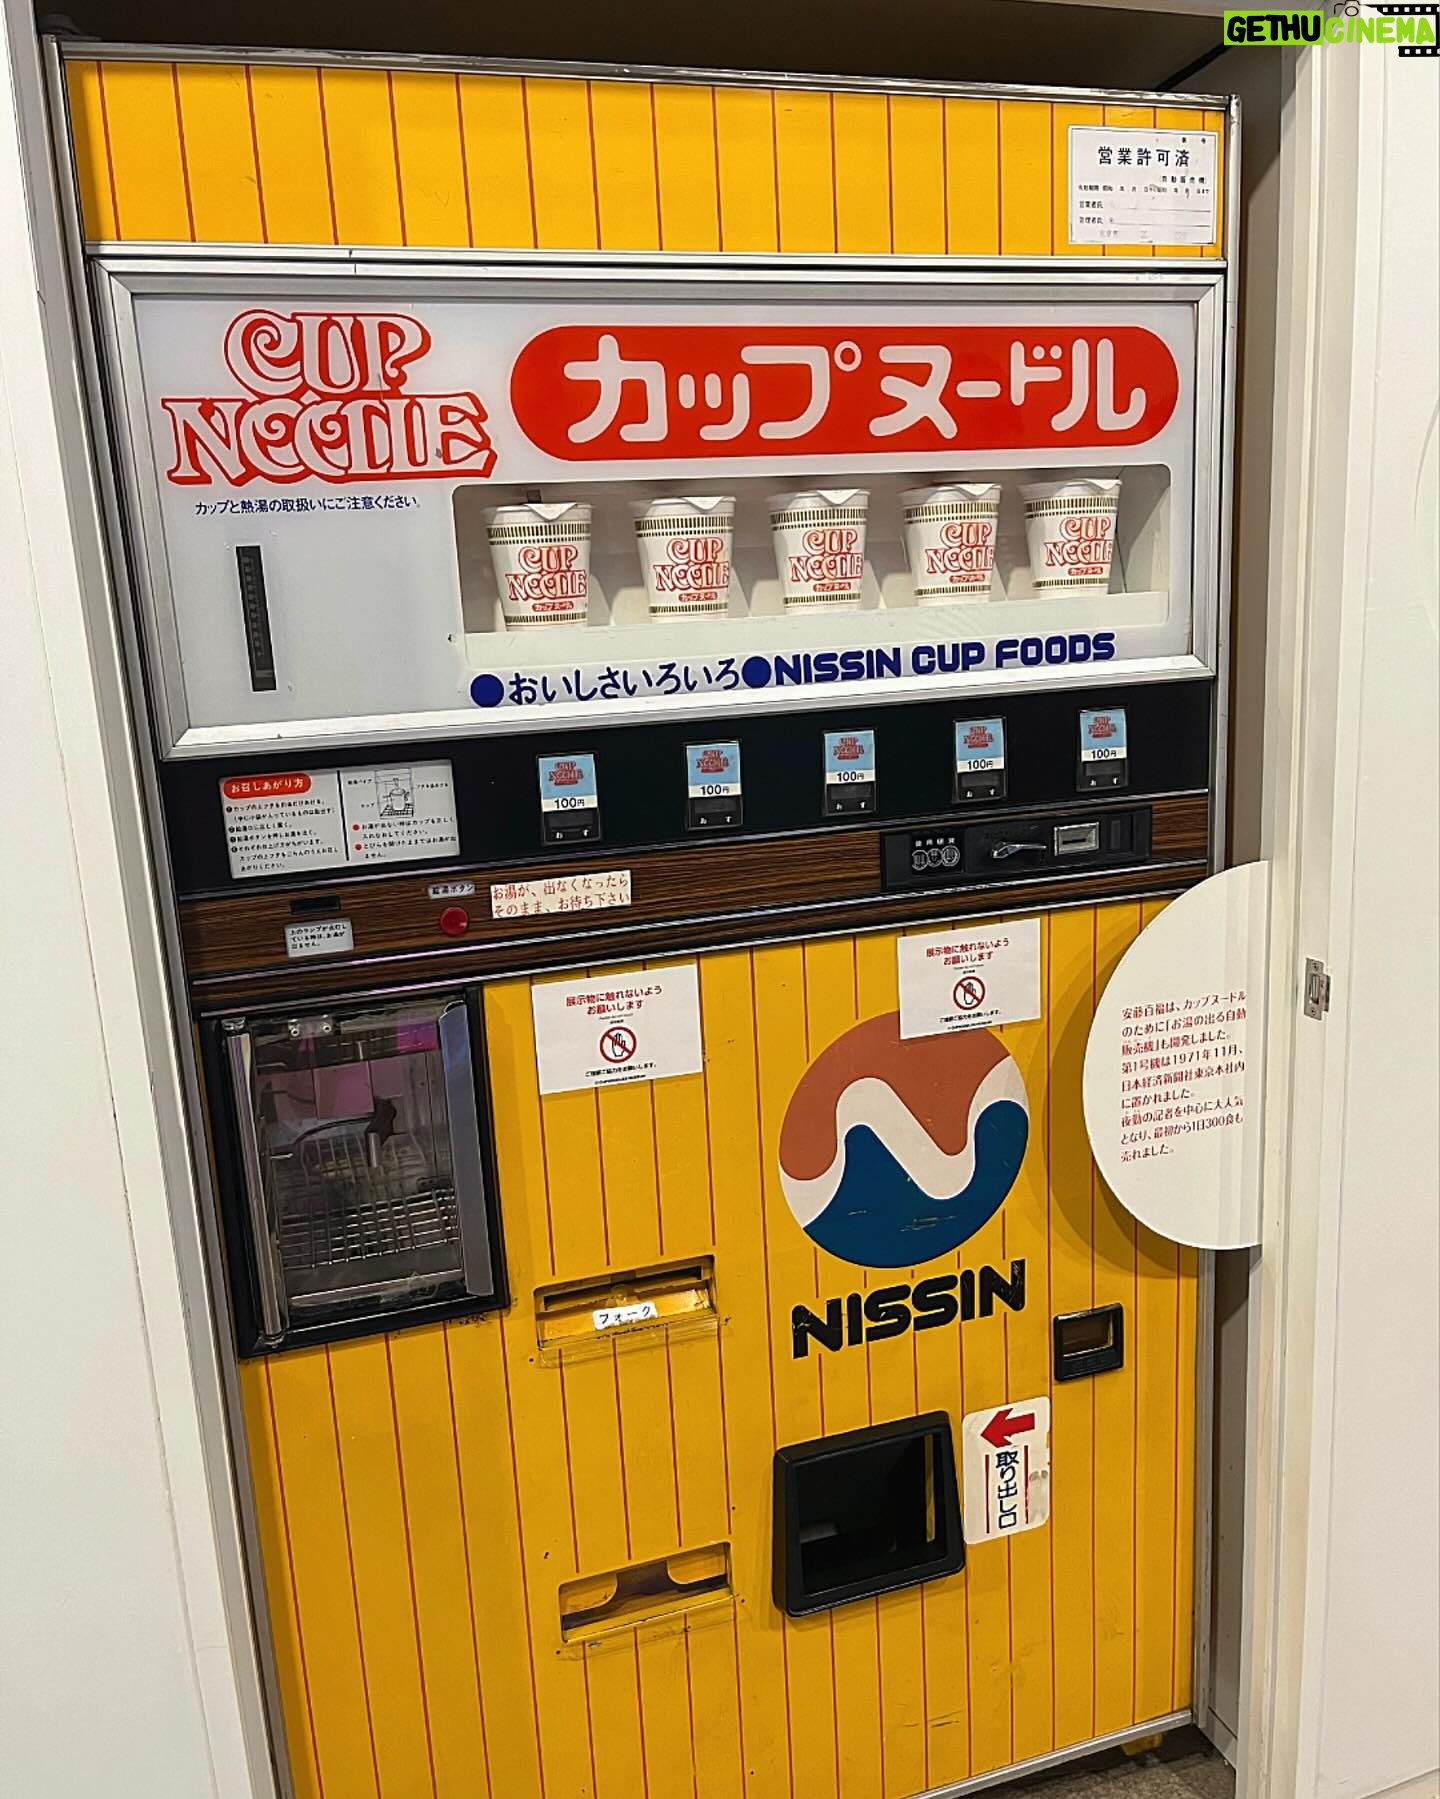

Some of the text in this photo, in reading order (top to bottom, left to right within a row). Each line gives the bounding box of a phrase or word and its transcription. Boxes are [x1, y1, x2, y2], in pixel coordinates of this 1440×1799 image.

[1098, 146, 1190, 167] 営業許可済
[223, 309, 432, 397] CUP
[563, 334, 1147, 444] カップヌードル
[160, 392, 498, 487] NOODLE
[195, 495, 421, 516] カップと熱湯の取扱いにご注意ください。
[940, 522, 992, 549] CUP
[1060, 517, 1111, 542] CUP
[667, 537, 724, 567] CUP
[803, 529, 858, 555] CUP
[518, 545, 578, 574] CUP
[508, 632, 1115, 706] おいしさいろいろ NISSIN CUP FOODS
[967, 759, 994, 770] 100円
[1091, 748, 1117, 760] 100円
[231, 778, 304, 793] お召しあがり方
[837, 772, 864, 782] 100円
[700, 784, 729, 796] 100円
[554, 797, 585, 809] 100円
[494, 893, 630, 917] そのまま、お待ち下さい
[926, 937, 1010, 958] 展示物に触れないよう
[943, 951, 994, 965] お願いします
[566, 985, 662, 1007] 展示物に触れないよう
[587, 1000, 643, 1015] お願いします
[1120, 1143, 1175, 1163] 売れました。
[598, 1304, 655, 1326] フォーク
[791, 1258, 1026, 1360] NISSIN
[995, 1449, 1020, 1530] 取り出し口
